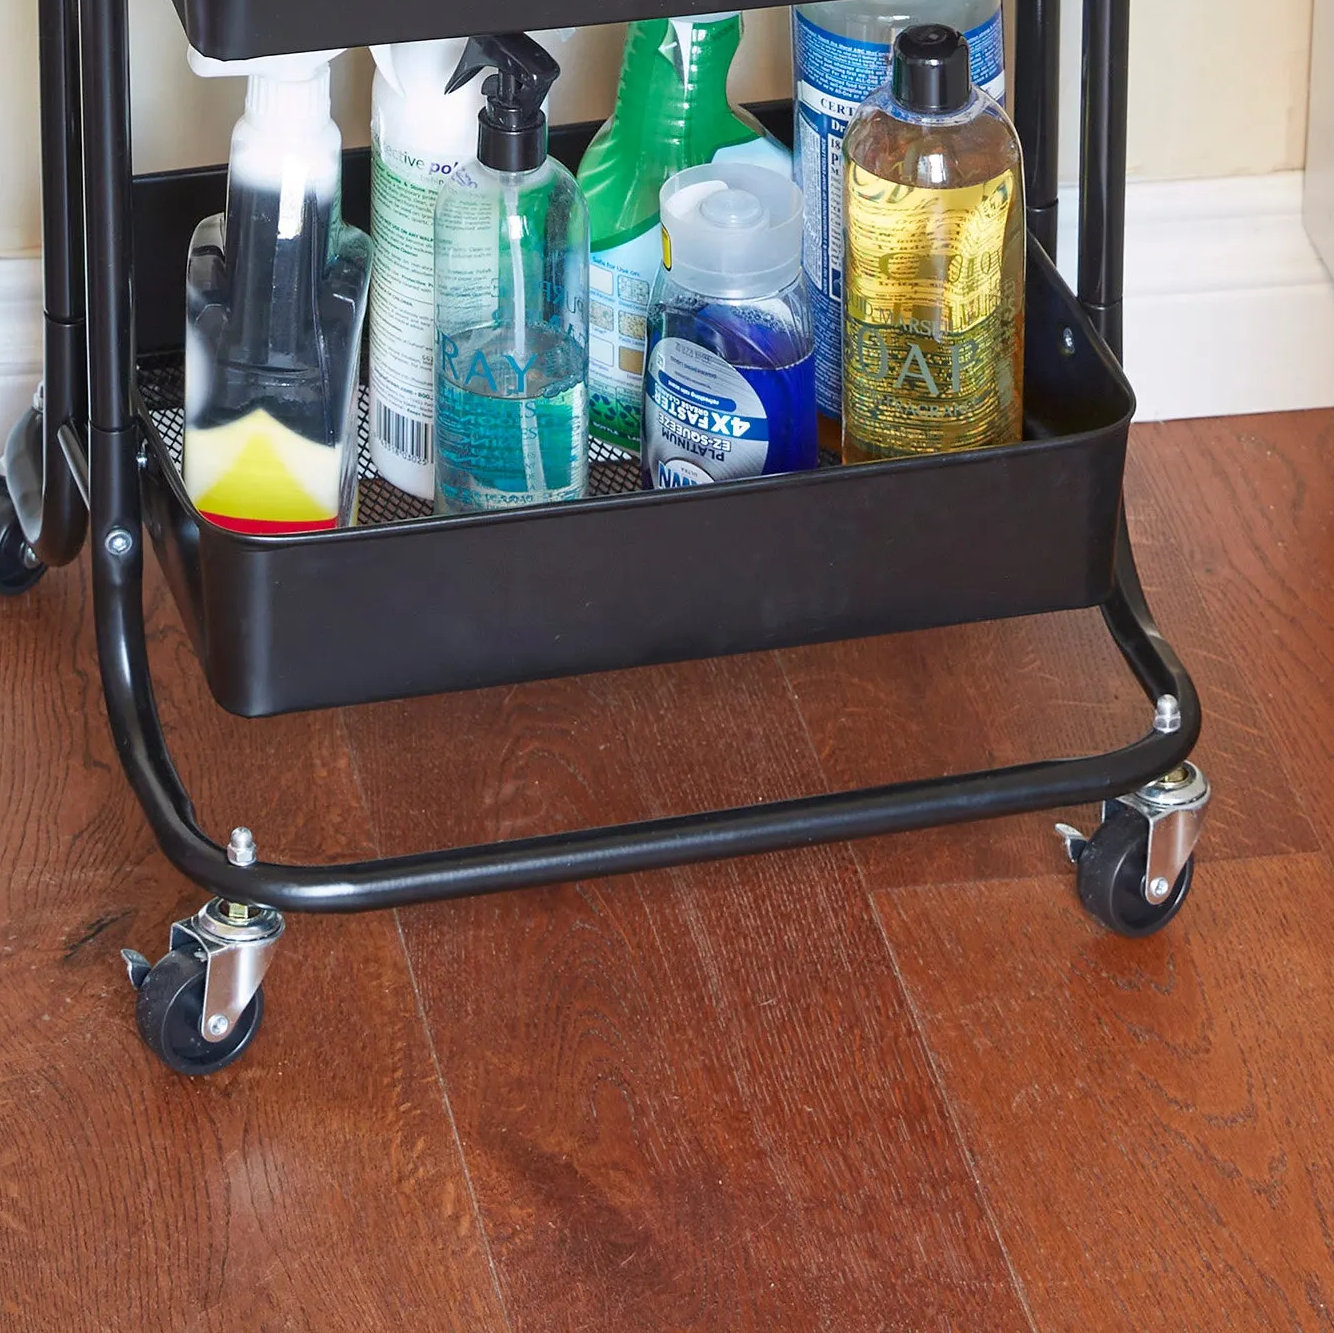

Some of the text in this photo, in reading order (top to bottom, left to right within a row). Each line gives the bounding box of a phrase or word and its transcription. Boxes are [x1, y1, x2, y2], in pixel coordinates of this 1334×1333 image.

[820, 97, 855, 117] CERT
[436, 331, 538, 393] RAY
[845, 326, 980, 396] OAP
[654, 382, 751, 437] 4X FASTER
[680, 399, 709, 417] GREASE
[690, 390, 720, 406] refreshing
[659, 410, 731, 452] EZ-SQUEEZE
[661, 427, 725, 461] PLATINUM
[680, 467, 698, 477] ULTRA
